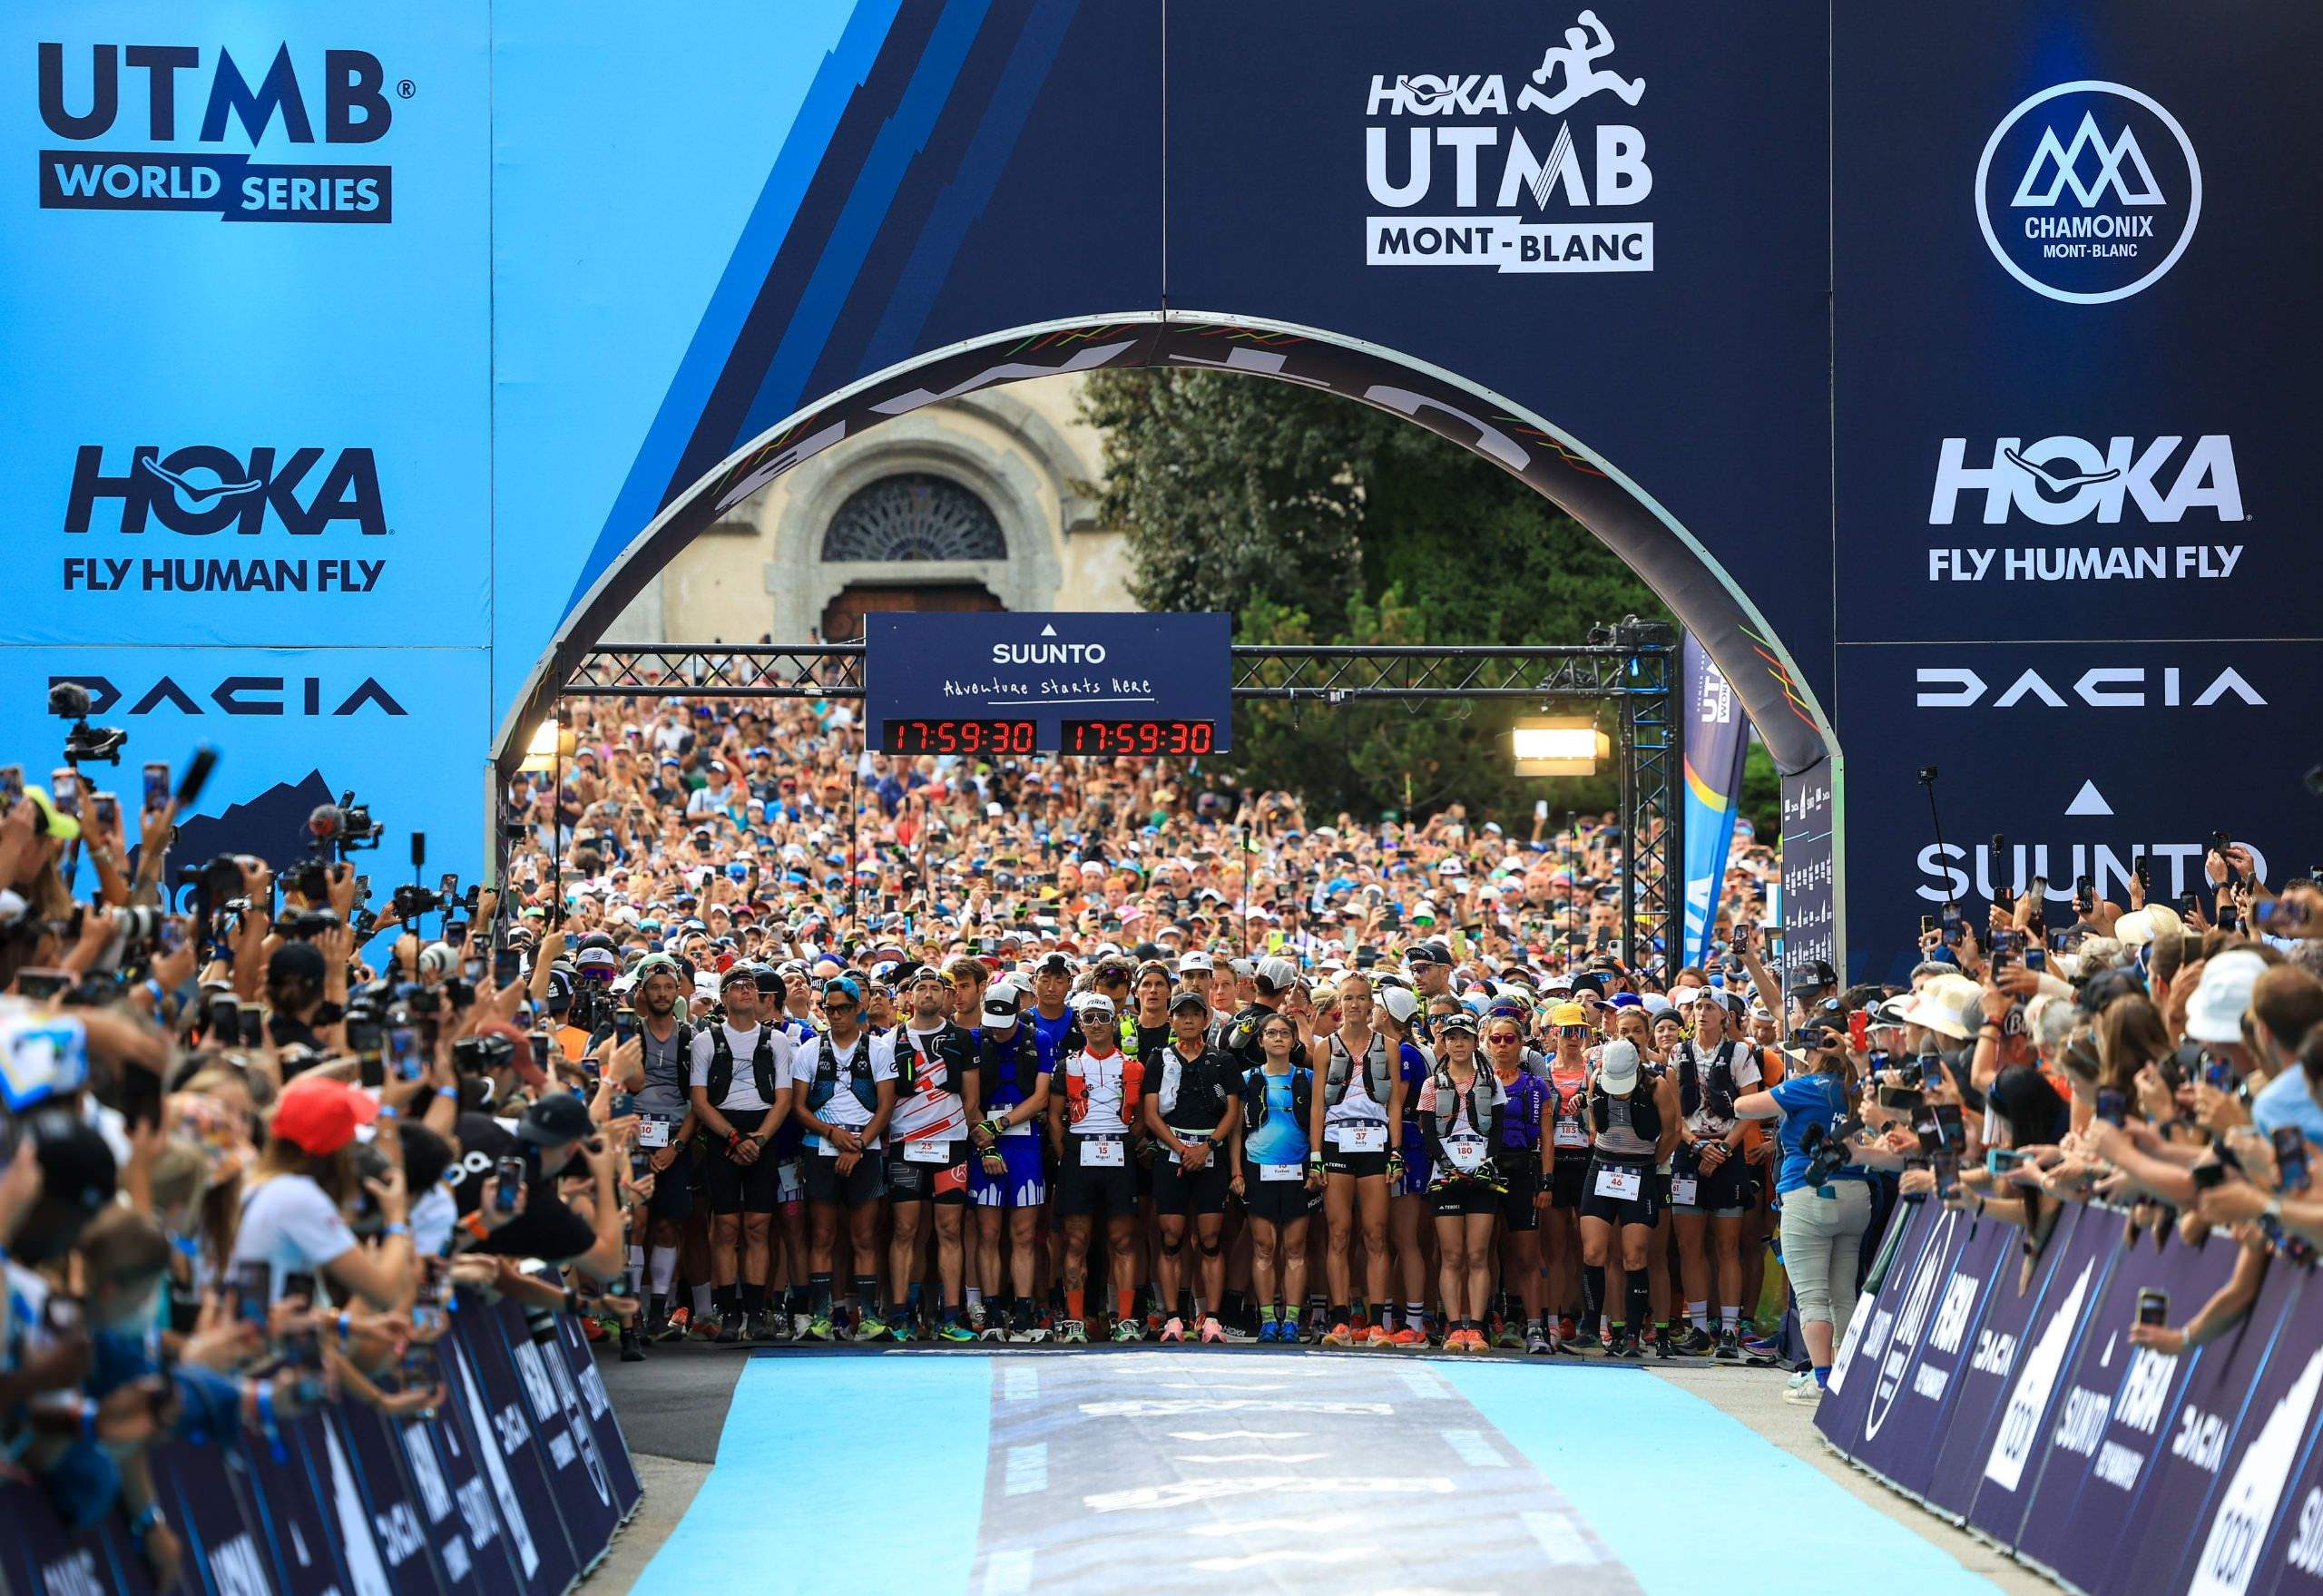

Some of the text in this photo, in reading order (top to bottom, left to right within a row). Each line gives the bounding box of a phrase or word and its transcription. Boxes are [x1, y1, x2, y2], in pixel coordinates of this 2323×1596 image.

[1366, 74, 1508, 115] HOKA
[1366, 120, 1653, 211] UTMB
[54, 163, 379, 211] WORLD SERIES
[2024, 214, 2154, 240] CHAMONIX
[2043, 243, 2138, 258] MONT-BLANC
[64, 445, 387, 535] HOKA
[1928, 435, 2245, 525] HOKA
[64, 558, 387, 592] FLY HUMAN FLY
[1928, 544, 2244, 582] FLY HUMAN FLY
[993, 643, 1106, 664] SUUNTO
[48, 676, 409, 715] DACIA
[1916, 666, 2269, 707] DACIA
[897, 722, 1034, 753] 17:59:30
[1075, 723, 1211, 754] 17:59:30
[1612, 1178, 1622, 1186] 46
